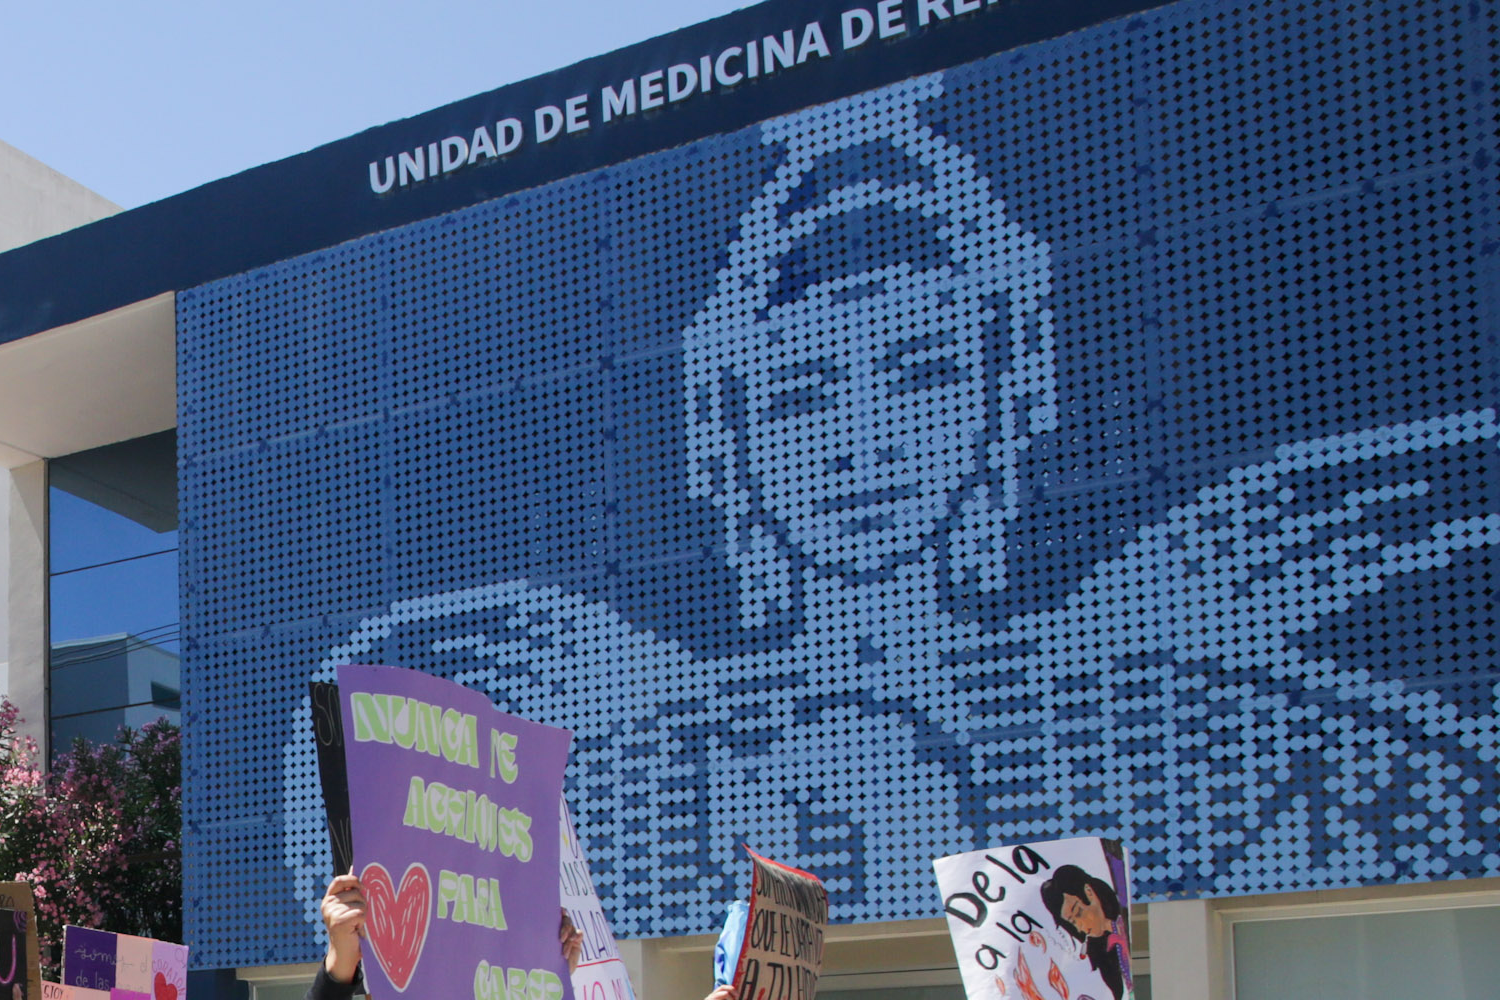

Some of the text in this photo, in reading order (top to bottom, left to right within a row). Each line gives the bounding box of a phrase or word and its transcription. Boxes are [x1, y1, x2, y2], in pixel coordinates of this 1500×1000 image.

[369, 117, 524, 194] UNIDAD
[535, 93, 590, 144] DE
[601, 20, 831, 123] MEDICINA
[841, 0, 907, 50] DE
[351, 691, 480, 769] NUNCA
[437, 869, 508, 931] PARA
[944, 844, 1050, 929] De la
[751, 908, 777, 953] QUE
[975, 909, 1044, 971] a la
